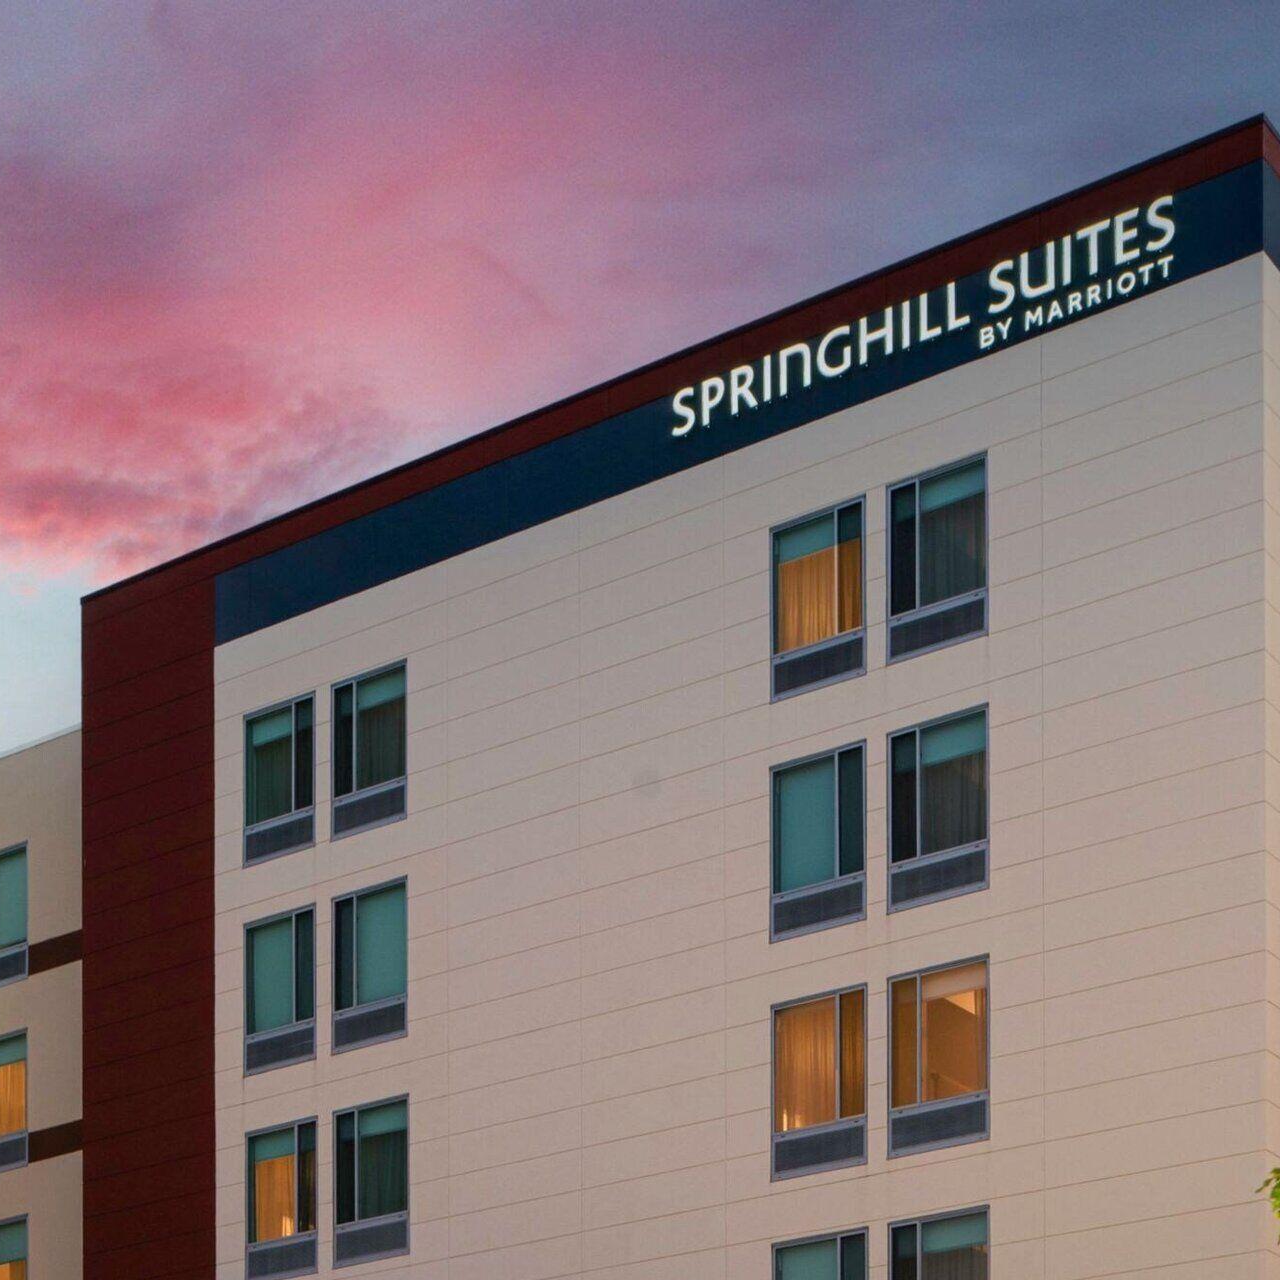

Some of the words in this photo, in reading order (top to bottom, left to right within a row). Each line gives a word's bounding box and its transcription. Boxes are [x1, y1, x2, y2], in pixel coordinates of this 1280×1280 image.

[671, 281, 970, 438] SPRINGHILL
[988, 195, 1176, 314] SUITES
[979, 317, 1013, 350] BY
[1024, 254, 1175, 333] MARRIOTT
